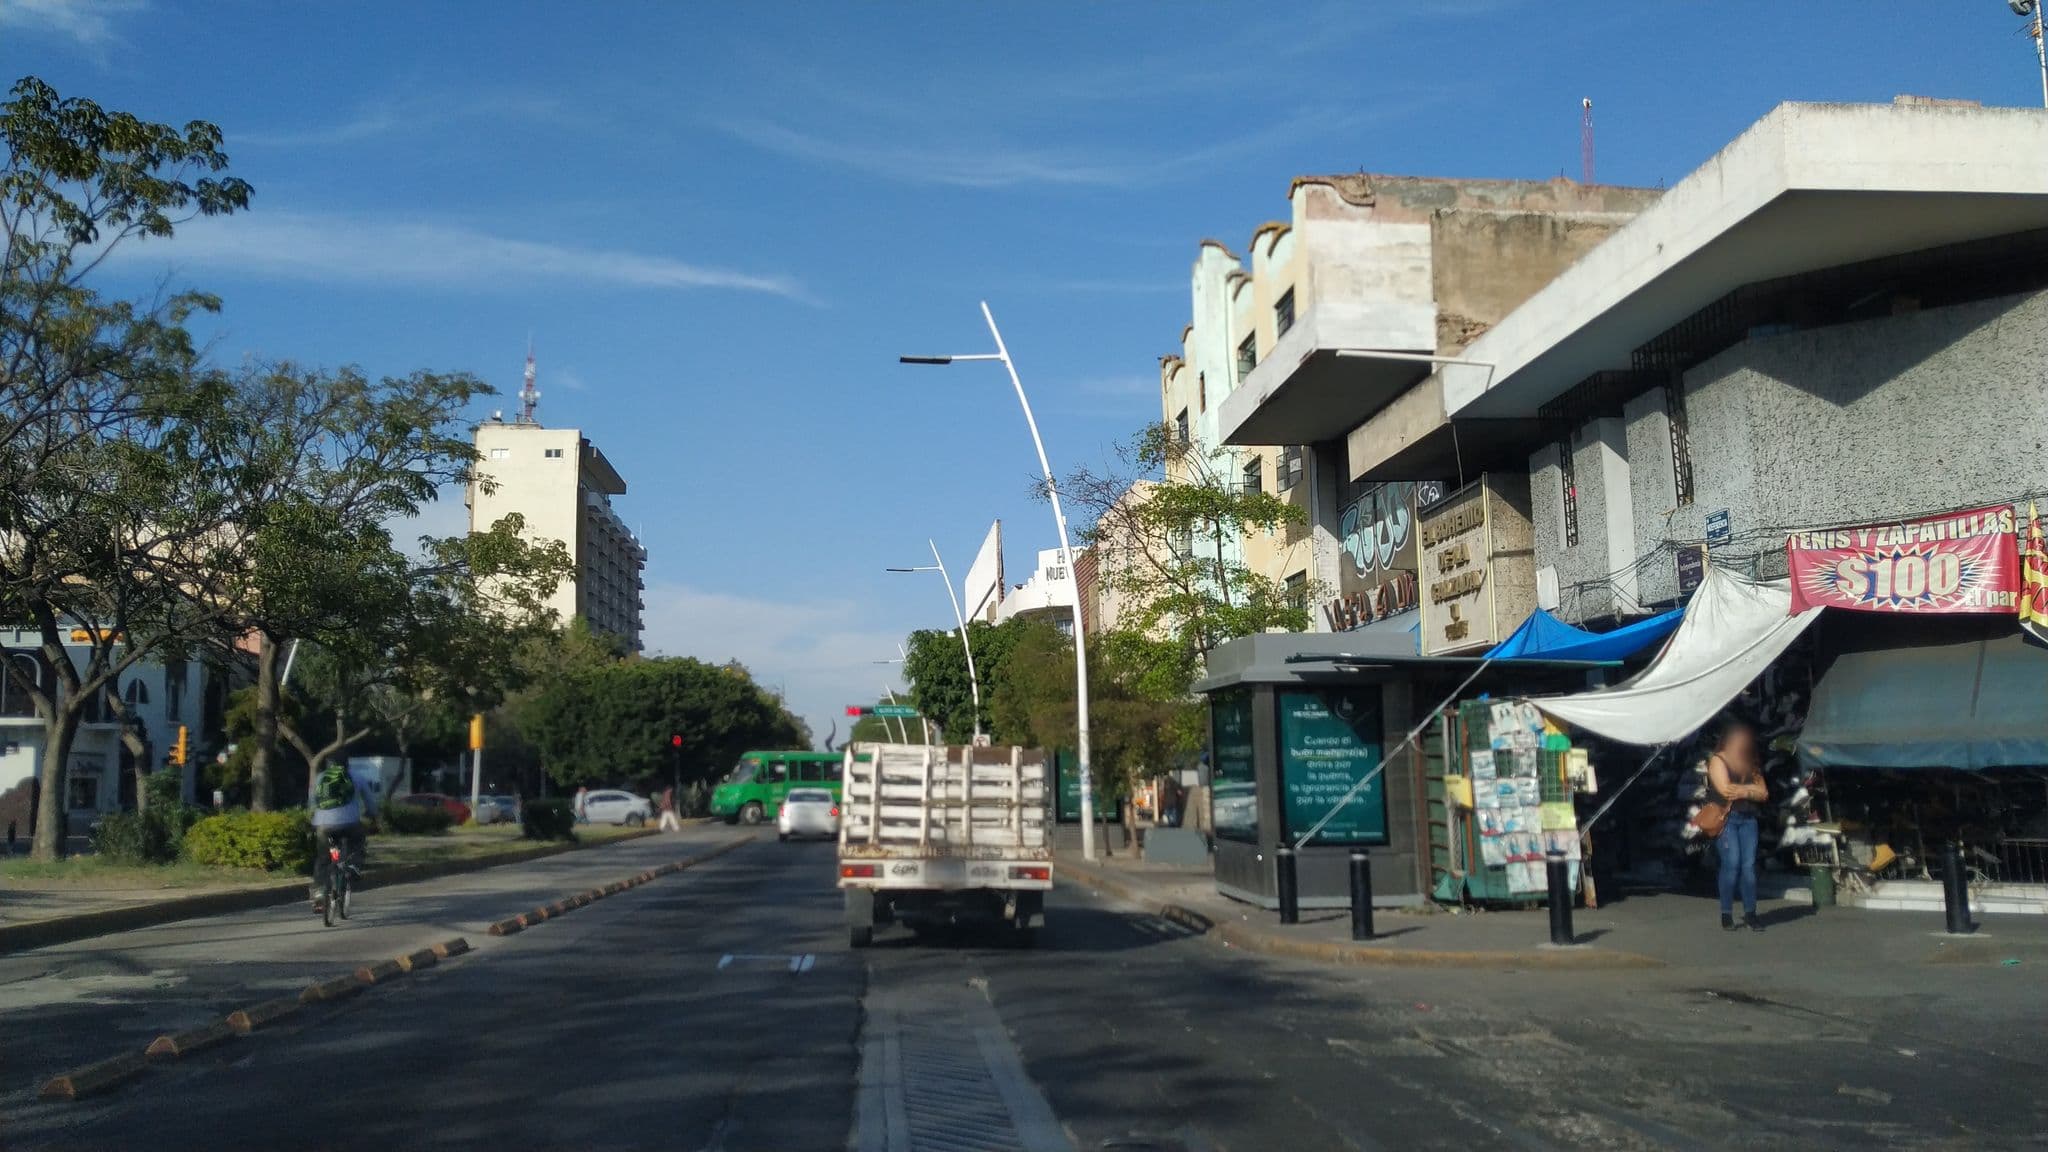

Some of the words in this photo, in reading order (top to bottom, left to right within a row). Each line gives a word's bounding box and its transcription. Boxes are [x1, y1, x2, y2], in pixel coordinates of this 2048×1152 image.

[1790, 532, 1852, 551] TENIS
[1853, 528, 1875, 548] Y
[1877, 509, 2014, 546] ZAPATILLAS
[1836, 552, 1961, 599] $100
[1986, 589, 2017, 608] par
